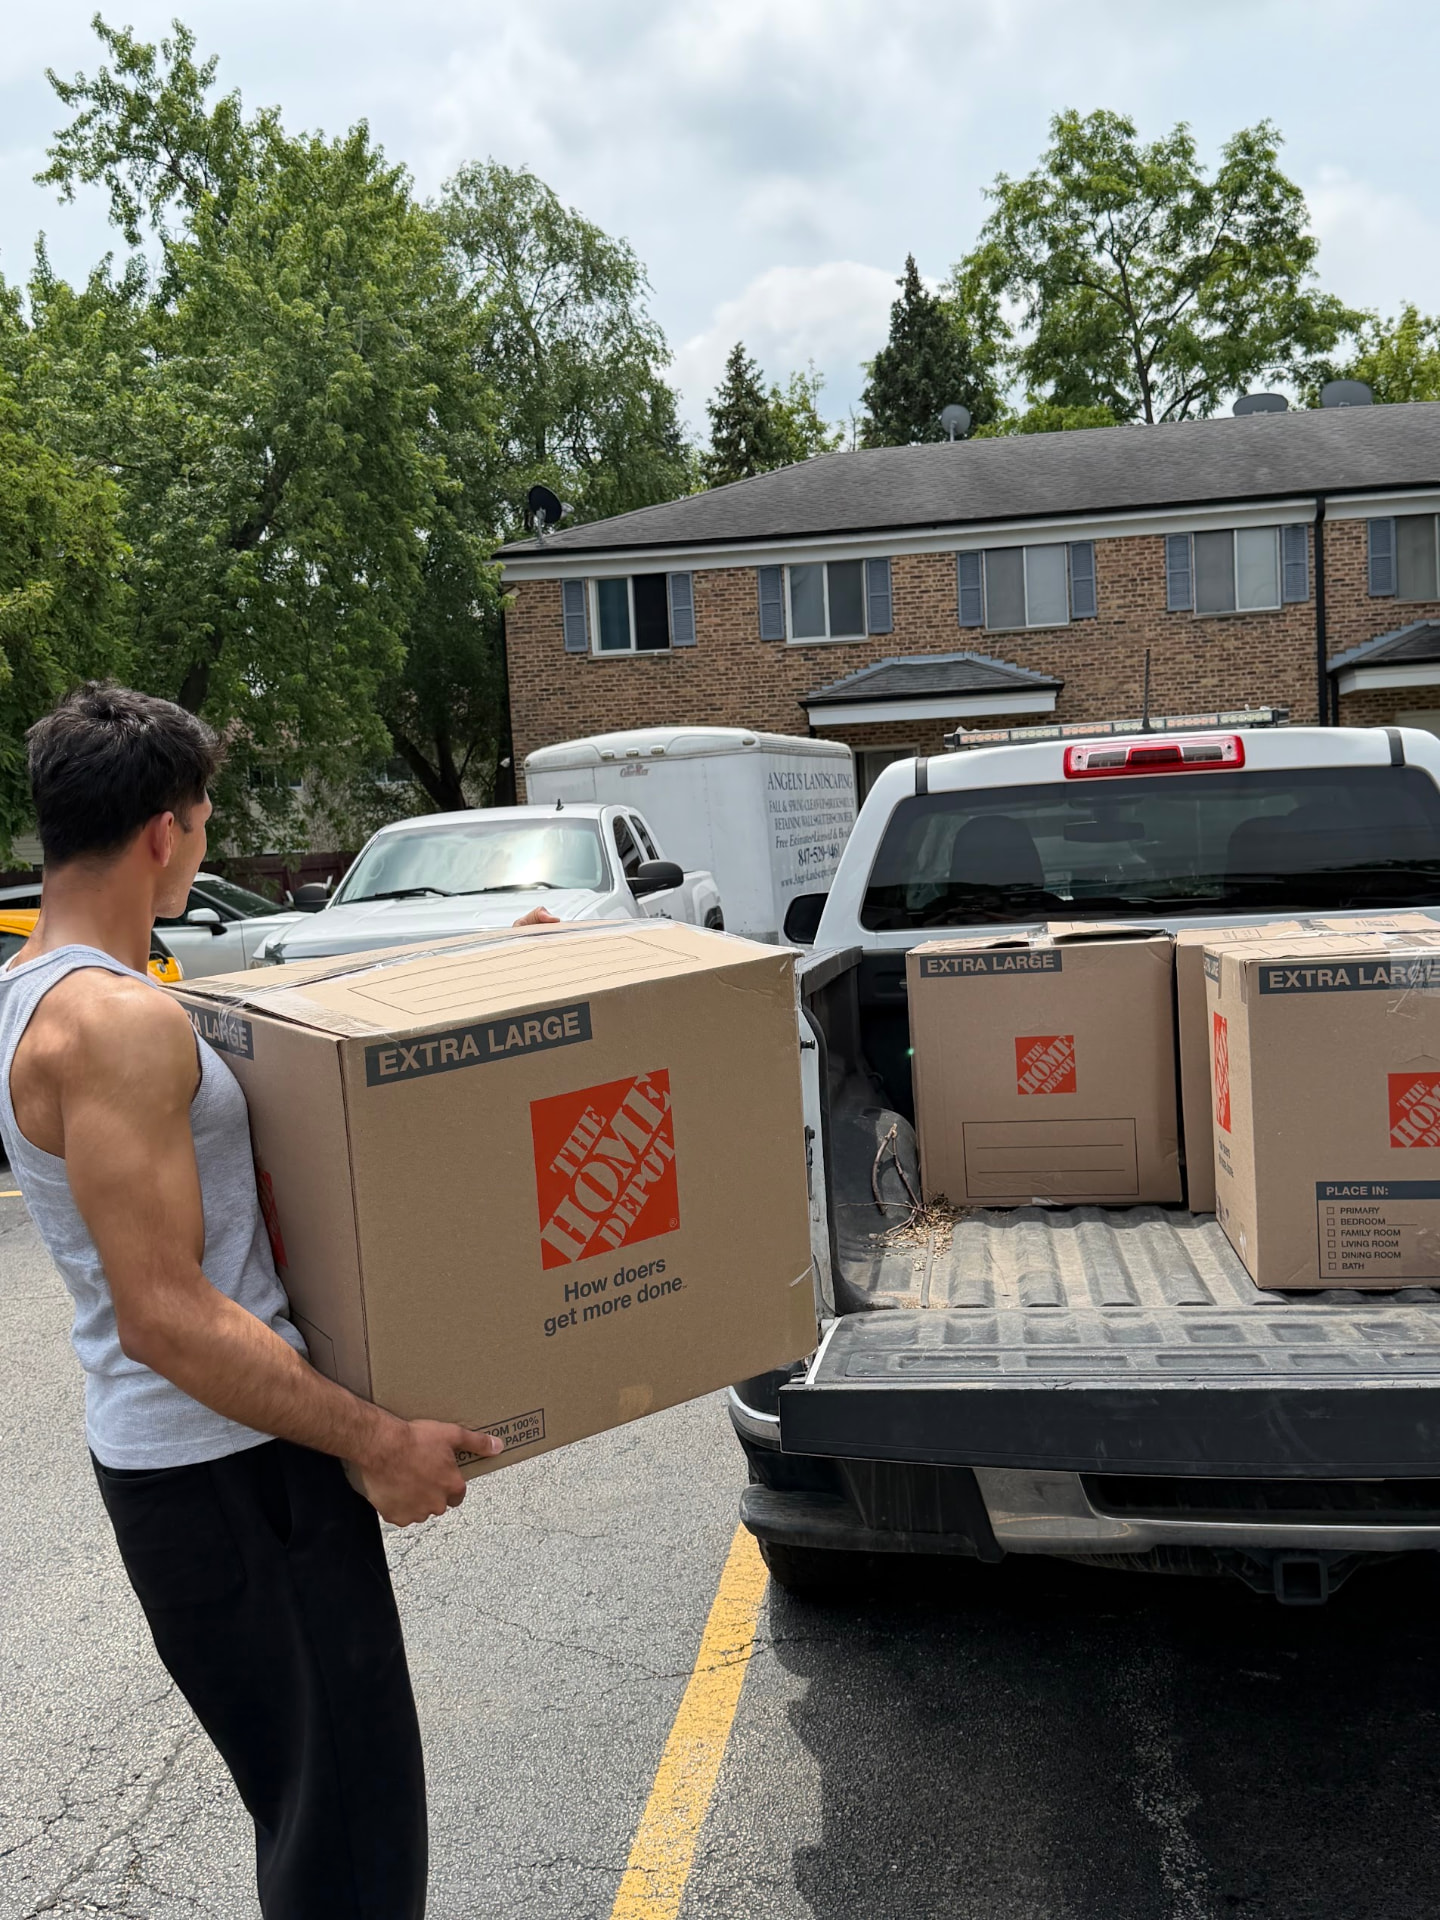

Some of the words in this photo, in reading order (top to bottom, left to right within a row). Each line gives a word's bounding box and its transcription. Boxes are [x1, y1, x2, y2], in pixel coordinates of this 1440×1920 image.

[803, 773, 853, 790] LANDSCAPING
[776, 835, 789, 848] Free
[927, 957, 988, 974] EXTRA
[992, 954, 1055, 971] LARGE
[1268, 968, 1351, 989] EXTRA
[1358, 964, 1440, 985] LARGE
[378, 1034, 481, 1077] EXTRA
[487, 1011, 581, 1054] LARGE
[1022, 1041, 1047, 1066] THE
[1017, 1035, 1075, 1094] HOME
[1040, 1056, 1076, 1093] DEPOT
[1396, 1080, 1430, 1111] THE
[549, 1105, 607, 1179] THE
[540, 1073, 672, 1263] HOME
[598, 1130, 676, 1249] DEPOT
[1325, 1186, 1369, 1196] PLACE
[1371, 1186, 1389, 1195] IN:
[1340, 1218, 1386, 1226] BEDROOM
[1340, 1229, 1372, 1237] FAMILY
[1373, 1229, 1401, 1237] ROOM
[1341, 1240, 1370, 1248] LIVING
[1371, 1240, 1399, 1248] ROOM
[1341, 1251, 1372, 1259] DINING
[1373, 1251, 1401, 1259] ROOM
[1342, 1262, 1365, 1270] BATH
[564, 1277, 608, 1302] How
[613, 1258, 666, 1287] doers
[543, 1308, 578, 1337] get
[583, 1294, 632, 1322] more
[512, 1416, 539, 1432] 100%
[505, 1427, 540, 1446] PAPER
